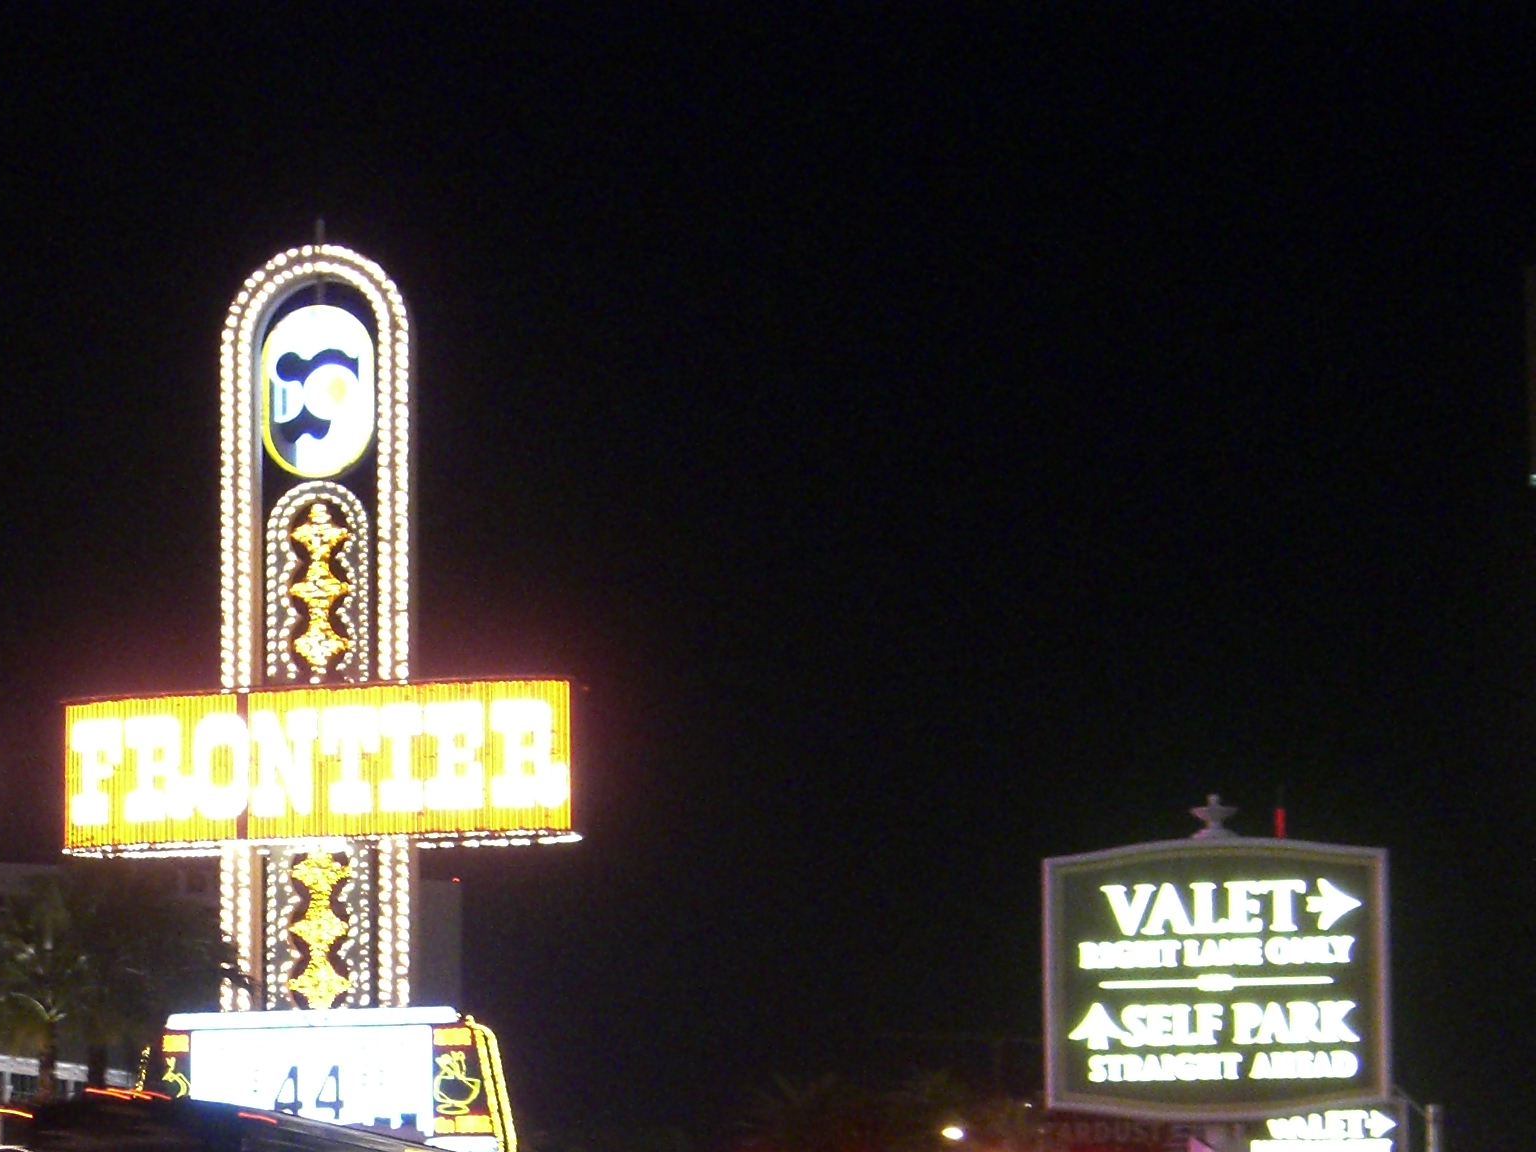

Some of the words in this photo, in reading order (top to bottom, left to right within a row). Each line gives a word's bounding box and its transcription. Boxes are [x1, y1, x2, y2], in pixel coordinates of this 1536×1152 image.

[70, 700, 566, 825] FRONTIER
[1100, 880, 1306, 936] VALET
[1079, 940, 1181, 969] RIGHT
[1183, 938, 1264, 967] LANE
[1265, 935, 1355, 965] ONLY
[1121, 1003, 1224, 1048] SELF
[1231, 1001, 1360, 1045] PARK
[1089, 1053, 1243, 1082] STRAIGHT
[1249, 1050, 1359, 1079] AHEAD
[1266, 1110, 1369, 1140] VALET
